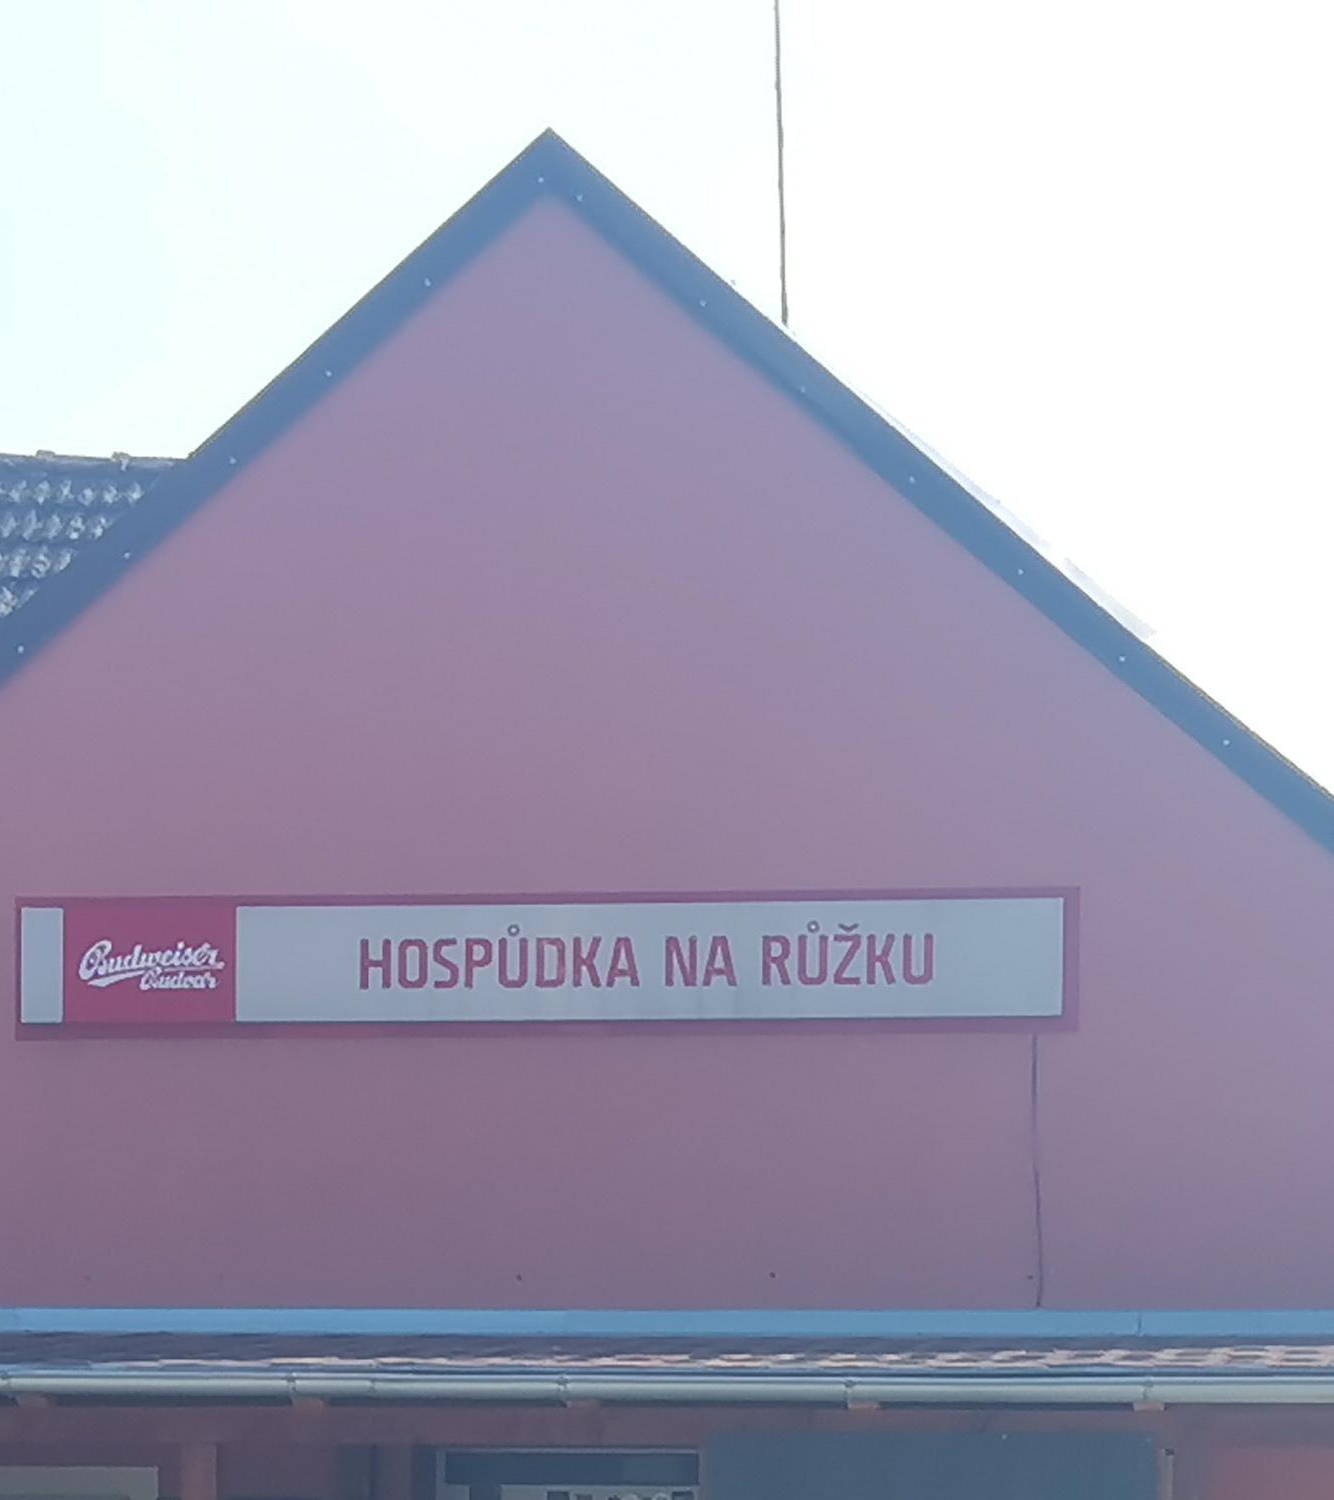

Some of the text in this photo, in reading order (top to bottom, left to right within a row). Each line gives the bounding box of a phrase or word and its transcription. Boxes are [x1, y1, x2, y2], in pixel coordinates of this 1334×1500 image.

[78, 940, 225, 982] Budweiser
[359, 920, 934, 990] HOSPŮDKA NA RŮŽKU
